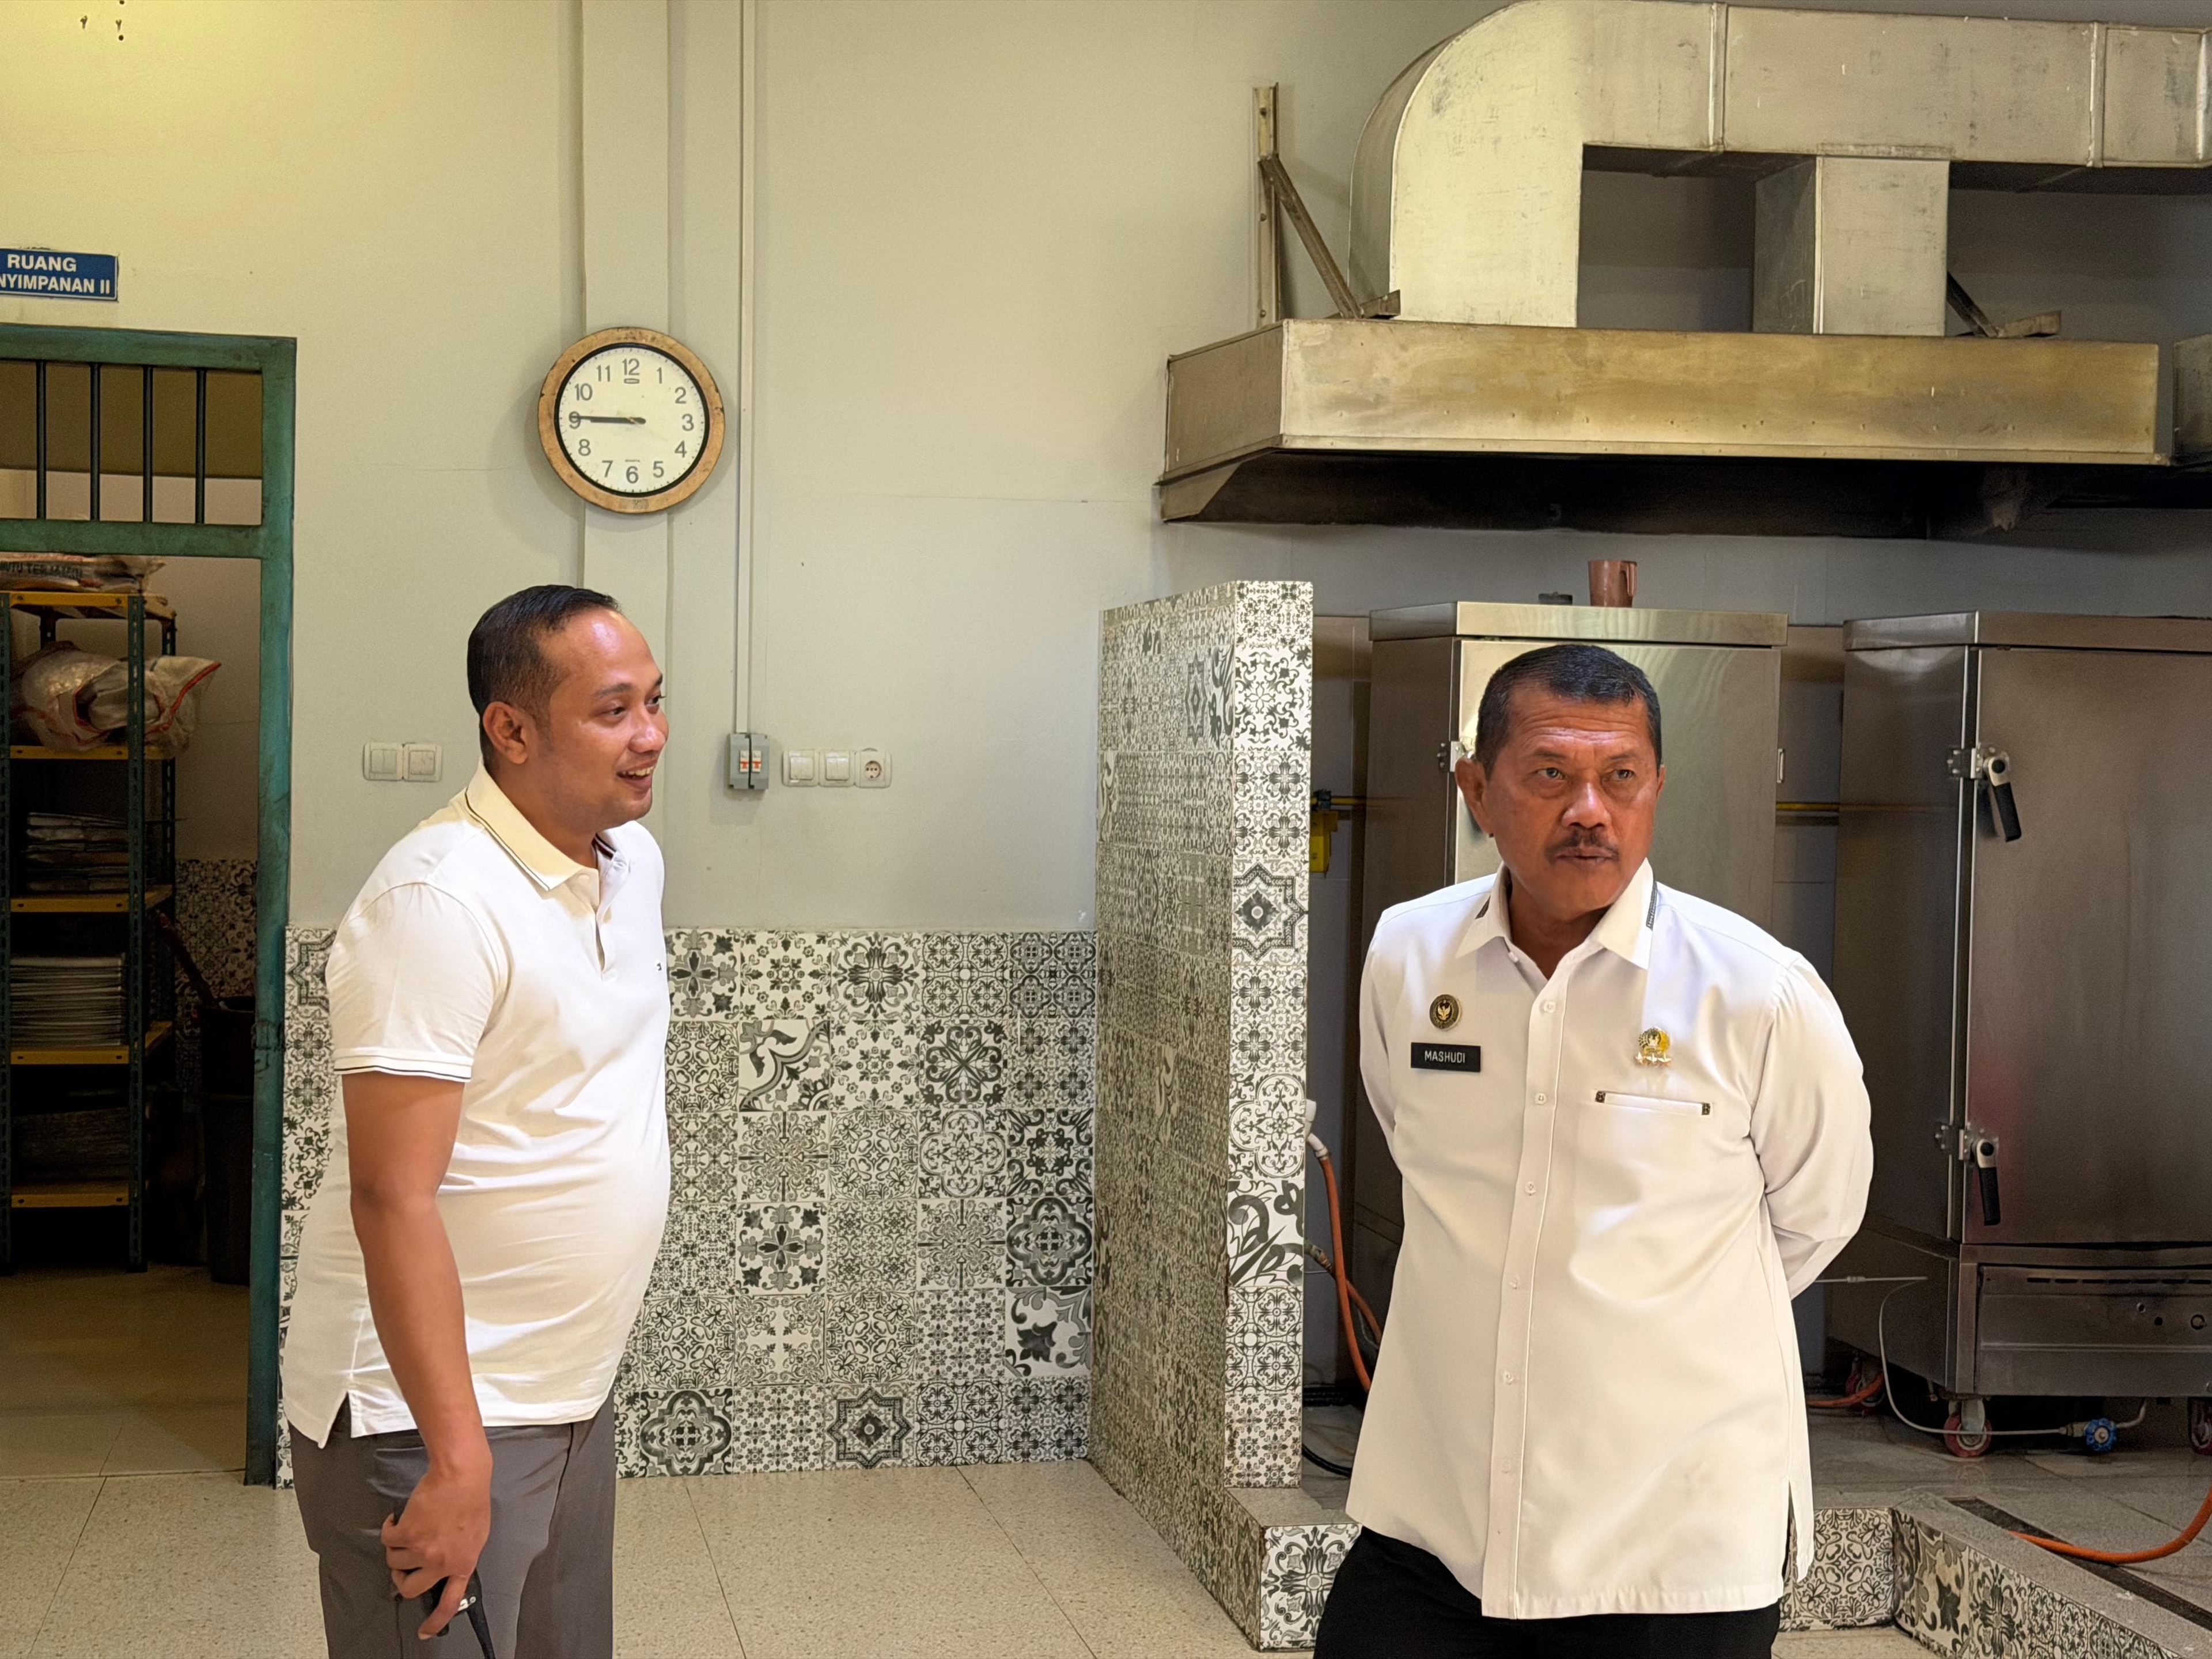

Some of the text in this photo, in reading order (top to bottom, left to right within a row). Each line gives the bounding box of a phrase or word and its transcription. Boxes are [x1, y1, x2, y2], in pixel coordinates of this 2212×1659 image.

[7, 253, 77, 272] RUANG
[100, 279, 109, 294] II
[596, 365, 611, 382] 11
[622, 358, 639, 375] 12
[657, 367, 662, 384] 1
[574, 383, 593, 400] 10
[675, 387, 687, 404] 2
[569, 411, 581, 429] 9
[682, 414, 694, 431] 3
[578, 439, 591, 456] 8
[675, 441, 687, 457] 4
[602, 460, 613, 478] 7
[626, 465, 638, 483] 6
[653, 461, 664, 478] 5
[1425, 1050, 1465, 1063] MASHUDI
